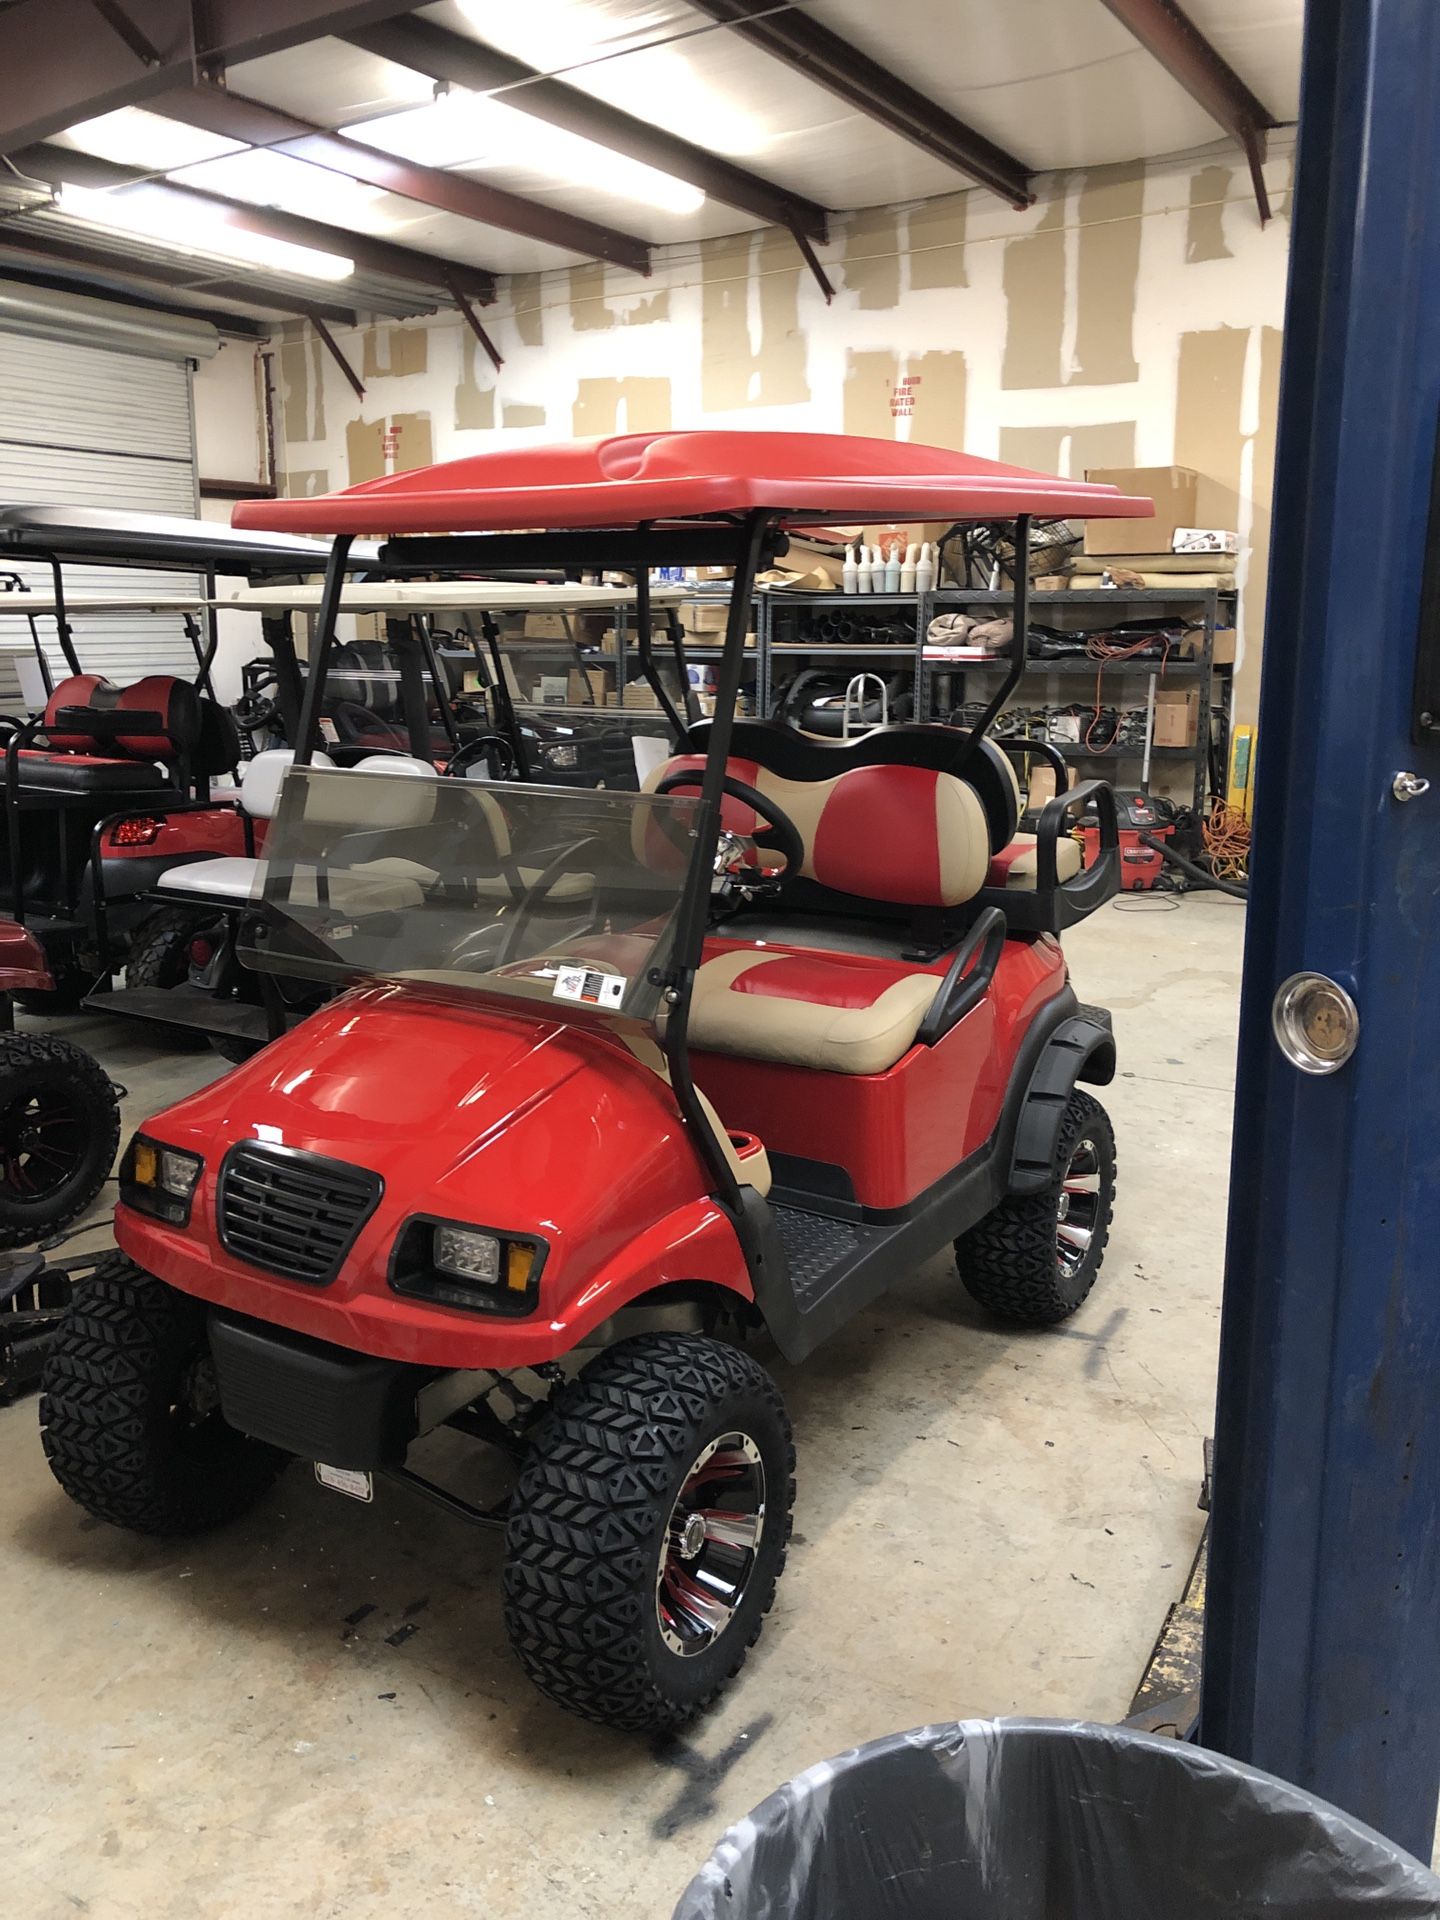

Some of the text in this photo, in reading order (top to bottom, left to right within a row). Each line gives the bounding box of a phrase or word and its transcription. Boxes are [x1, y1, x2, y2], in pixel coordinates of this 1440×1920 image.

[893, 387, 912, 396] FIRE
[889, 397, 915, 407] RATED
[891, 408, 913, 417] WALL
